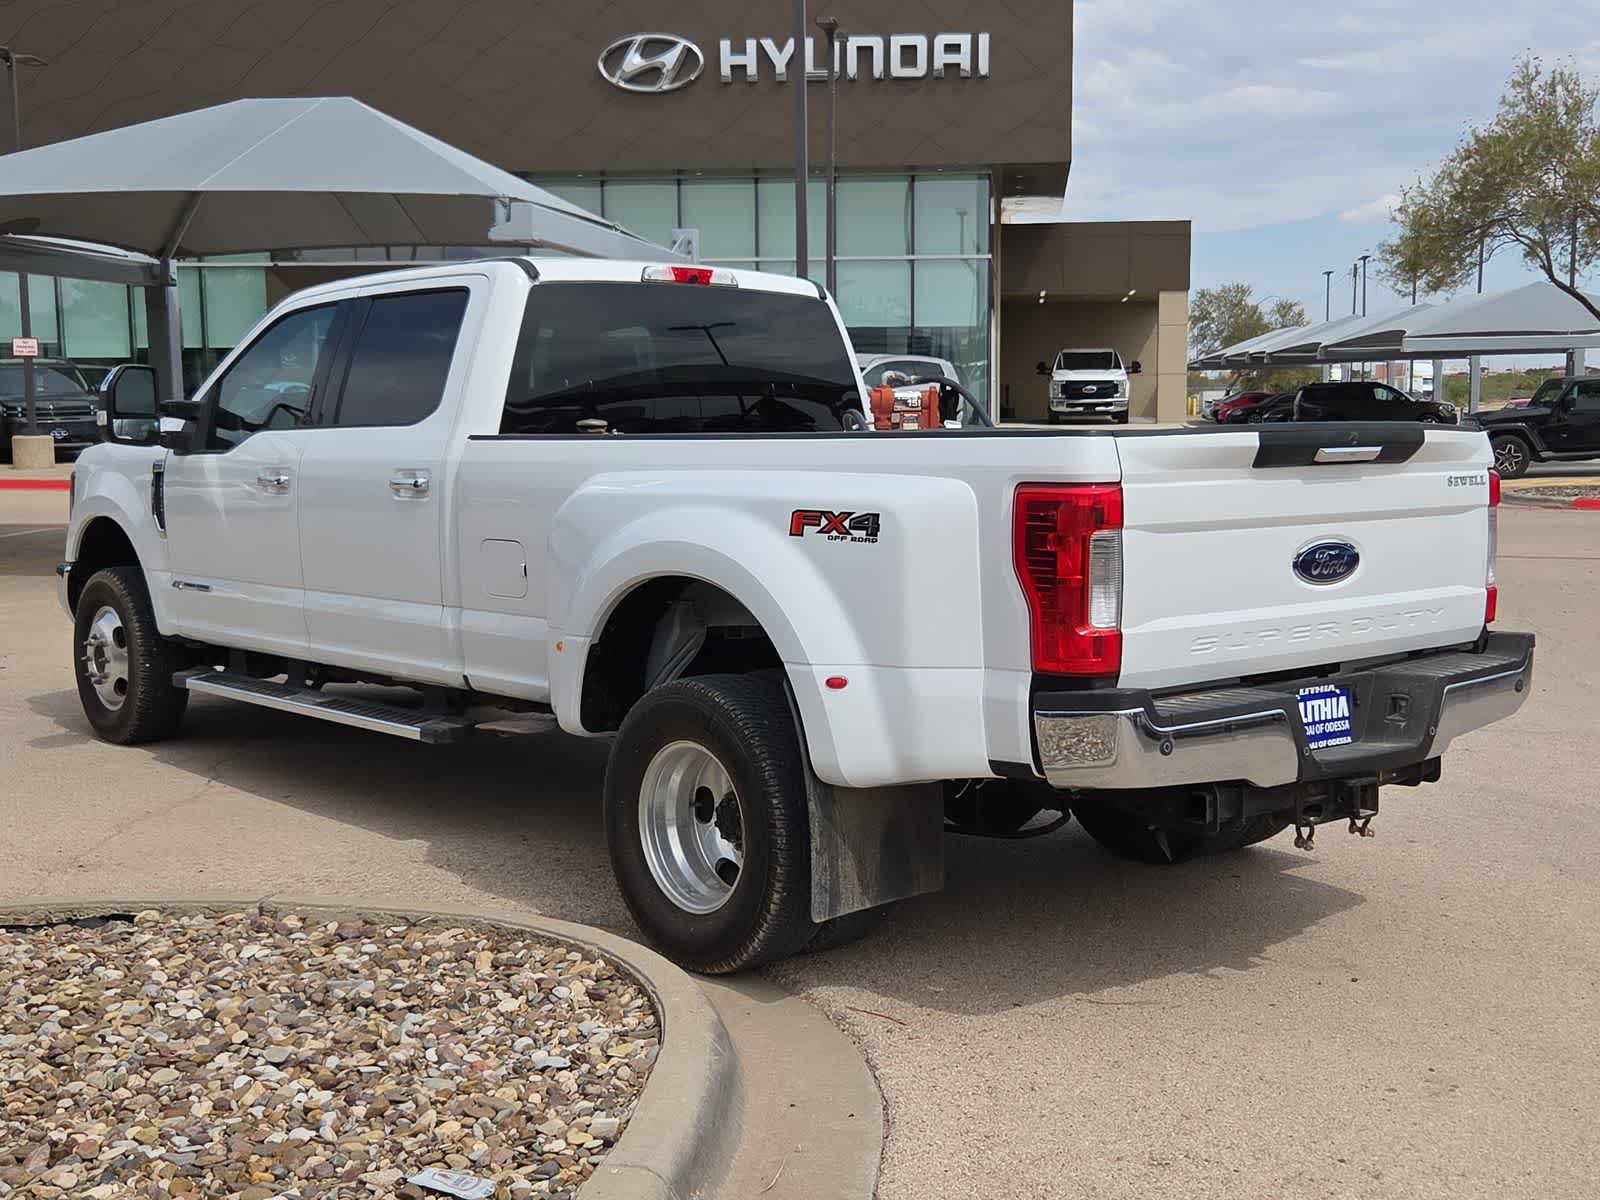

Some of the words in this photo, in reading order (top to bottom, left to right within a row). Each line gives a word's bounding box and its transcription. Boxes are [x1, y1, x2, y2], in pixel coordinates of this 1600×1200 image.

[719, 33, 990, 83] HYUNDAI
[1447, 475, 1487, 487] SEWELL
[789, 509, 880, 537] FX4
[1312, 549, 1348, 575] Ford
[1190, 622, 1341, 655] SUPER
[1350, 608, 1446, 635] DUTY
[1298, 696, 1350, 723] LITHIA
[1315, 723, 1324, 735] OF
[1325, 720, 1350, 733] ODESSA
